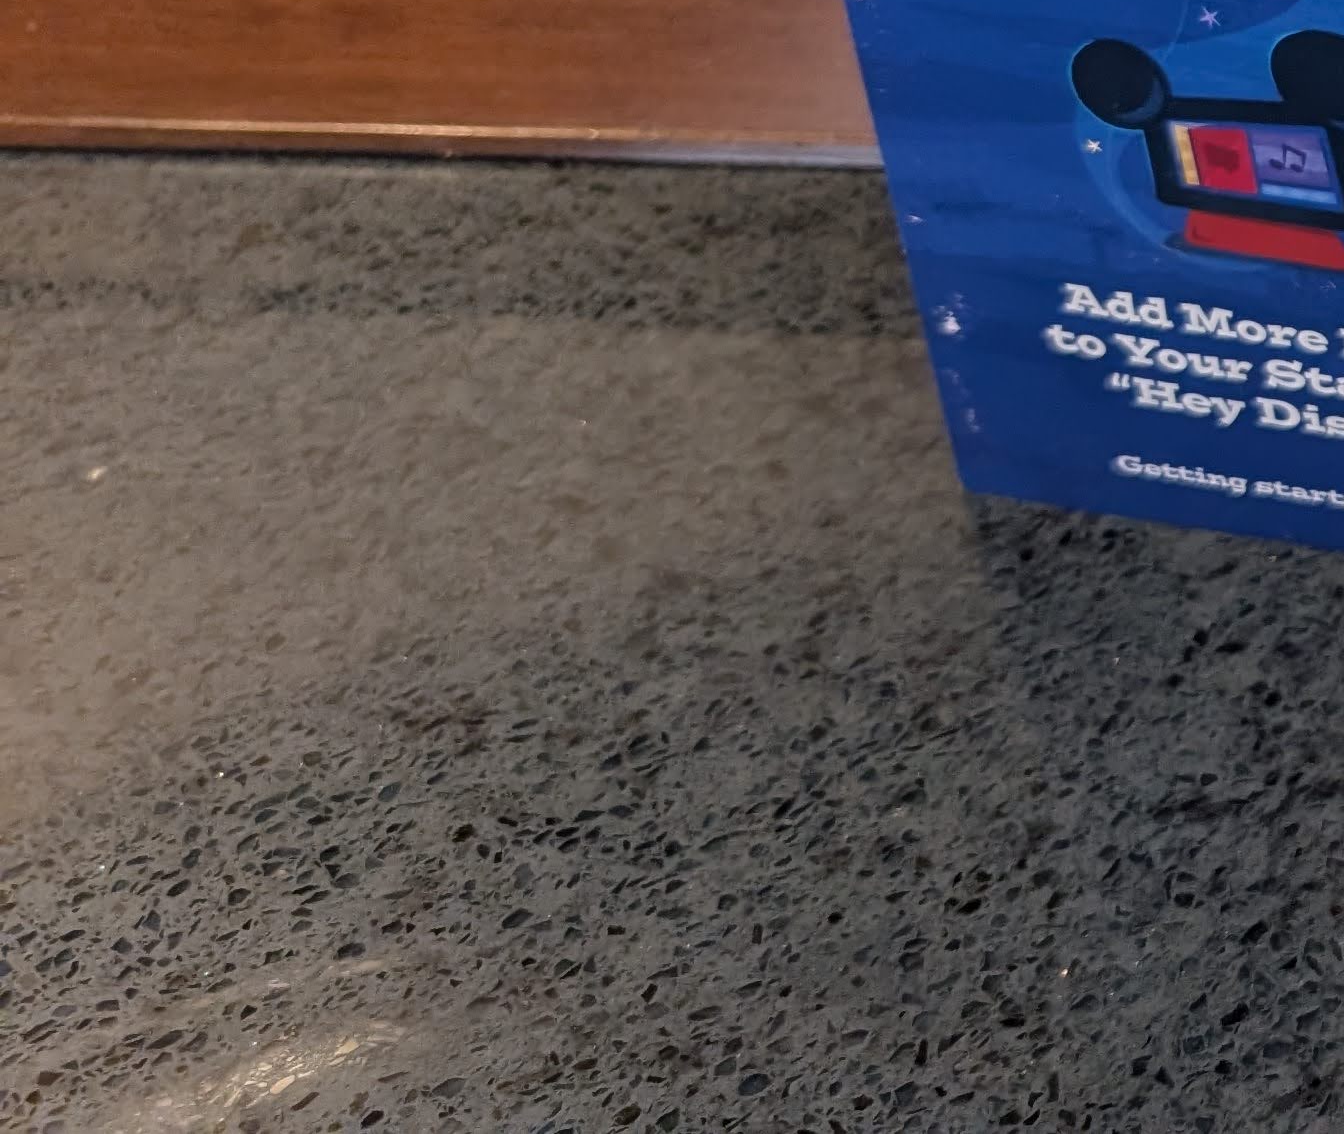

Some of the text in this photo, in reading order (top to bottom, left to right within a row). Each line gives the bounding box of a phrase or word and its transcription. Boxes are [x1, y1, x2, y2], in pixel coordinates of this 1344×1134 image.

[1063, 282, 1173, 330] Add
[1178, 302, 1328, 354] More
[1043, 323, 1106, 360] to
[1113, 332, 1253, 382] Your
[1112, 454, 1247, 497] Getting
